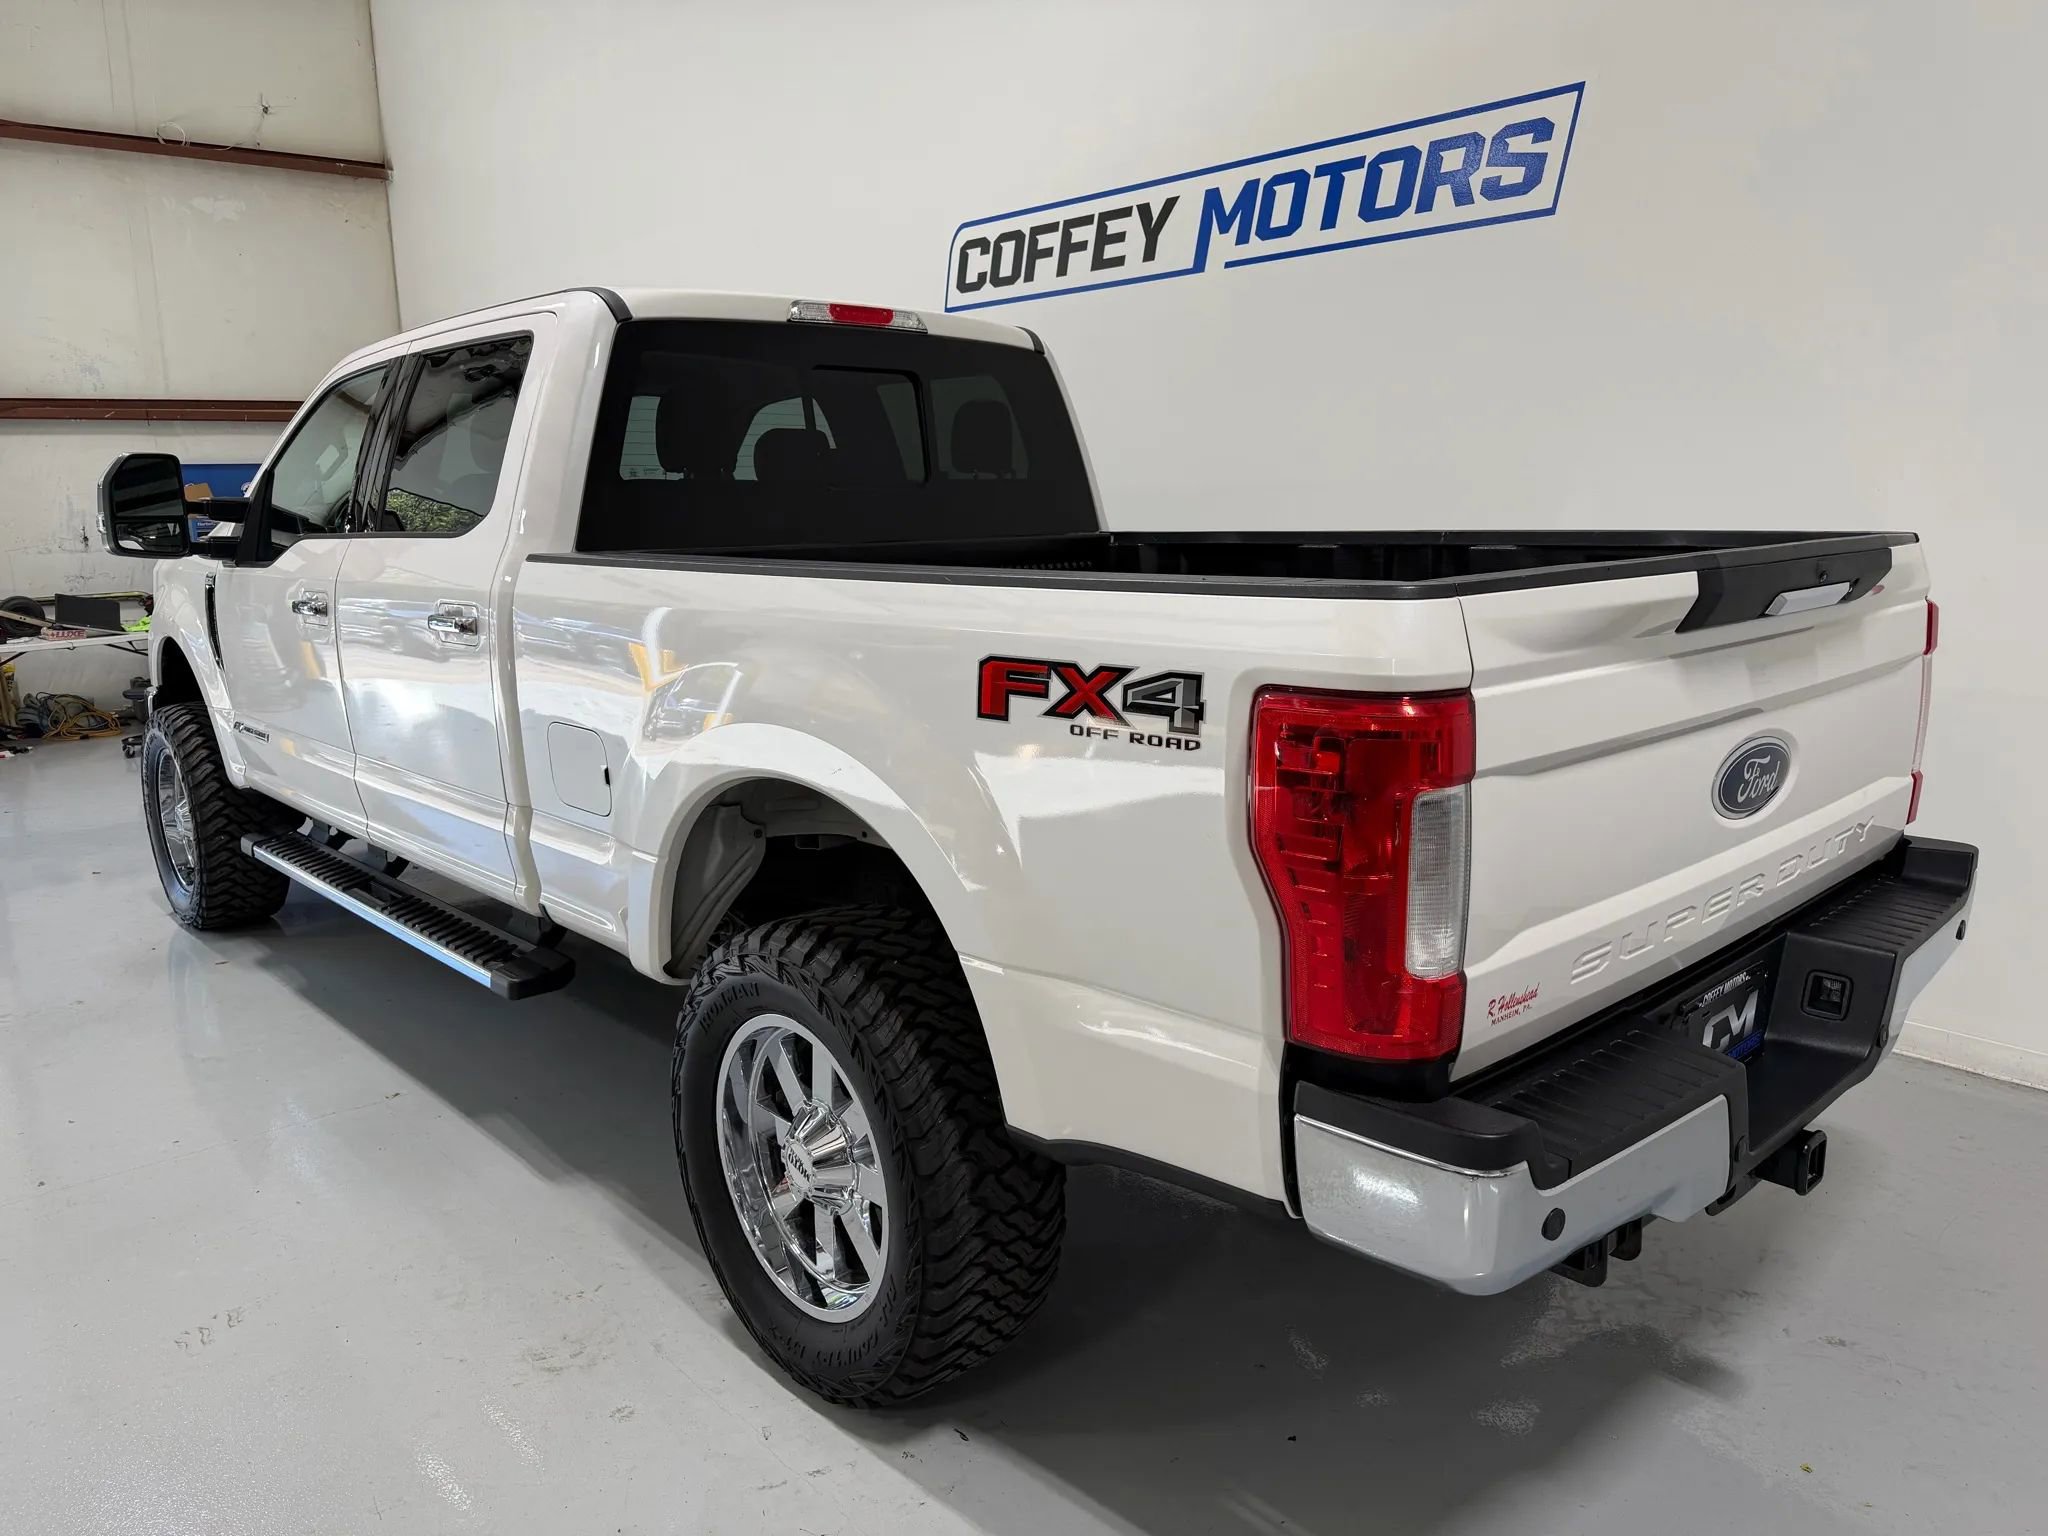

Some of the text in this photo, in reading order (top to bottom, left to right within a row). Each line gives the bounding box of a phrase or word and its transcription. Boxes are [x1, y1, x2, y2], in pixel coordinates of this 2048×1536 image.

[956, 116, 1556, 294] COFFEY MOTORS
[977, 654, 1206, 735] FX4
[1070, 724, 1201, 751] OFF ROAD
[1737, 754, 1780, 803] Ford
[1569, 815, 1875, 985] SUPER DUTY
